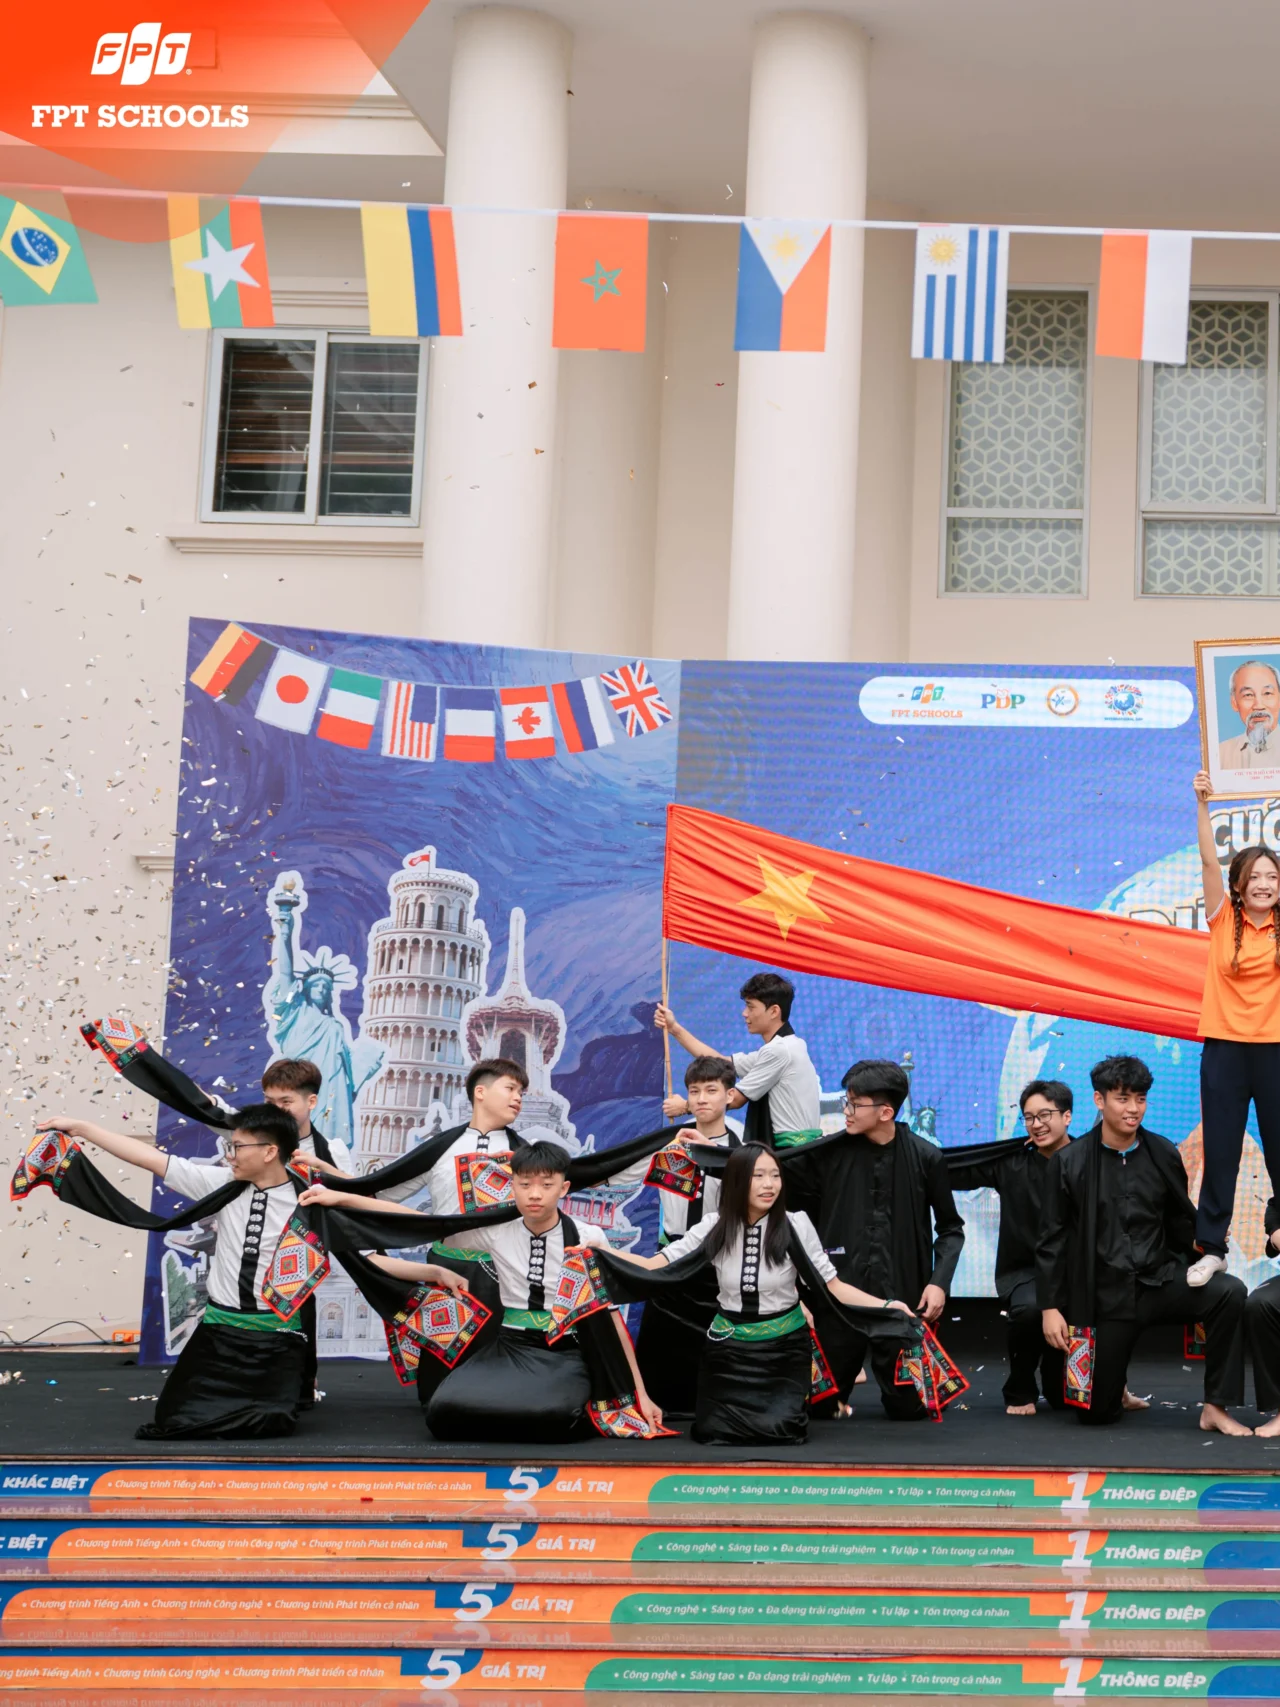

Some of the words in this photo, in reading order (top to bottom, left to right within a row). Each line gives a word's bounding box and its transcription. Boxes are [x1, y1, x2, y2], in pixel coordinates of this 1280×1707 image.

[911, 683, 945, 704] FPT
[981, 692, 1026, 709] PDP
[891, 709, 910, 718] FPT
[912, 709, 963, 718] SCHOOLS
[2, 1474, 49, 1488] KHÁC
[50, 1474, 89, 1491] BIỆT
[115, 1480, 148, 1490] Chương
[150, 1480, 171, 1488] trình
[173, 1480, 197, 1490] Tiếng
[197, 1480, 216, 1488] Anh
[226, 1480, 259, 1491] Chương
[260, 1481, 282, 1489] trình
[282, 1480, 305, 1492] Công
[306, 1481, 329, 1492] nghệ
[338, 1481, 372, 1492] Chương
[373, 1481, 394, 1490] trình
[394, 1481, 416, 1490] Phát
[416, 1481, 437, 1490] triển
[438, 1482, 449, 1490] cá
[450, 1482, 472, 1490] nhân
[503, 1466, 541, 1501] 5
[556, 1478, 582, 1492] GIÁ
[587, 1481, 614, 1494] TRỊ
[1061, 1472, 1090, 1508] 1
[1102, 1486, 1156, 1501] THÔNG
[1159, 1486, 1197, 1503] ĐIỆP
[7, 1534, 48, 1550] BIỆT
[480, 1523, 522, 1560] 5
[536, 1536, 563, 1550] GIÁ
[568, 1538, 596, 1552] TRỊ
[1061, 1531, 1092, 1567] 1
[1104, 1544, 1160, 1560] THÔNG
[1163, 1546, 1203, 1563] ĐIỆP
[454, 1583, 496, 1621] 5
[511, 1596, 540, 1611] GIÁ
[545, 1598, 574, 1614] TRỊ
[1058, 1591, 1091, 1629] 1
[1103, 1604, 1161, 1620] THÔNG
[1165, 1605, 1206, 1622] ĐIỆP
[12, 1668, 40, 1678] trình
[42, 1668, 70, 1680] Tiếng
[70, 1668, 92, 1678] Anh
[103, 1668, 142, 1680] Chương
[142, 1668, 167, 1678] trình
[168, 1668, 194, 1679] Công
[195, 1667, 221, 1680] nghệ
[232, 1667, 270, 1679] Chương
[271, 1667, 296, 1677] trình
[297, 1667, 320, 1677] Phát
[321, 1666, 345, 1677] triển
[346, 1668, 358, 1677] cá
[359, 1667, 385, 1677] nhân
[420, 1649, 465, 1689] 5
[480, 1662, 510, 1678] GIÁ
[516, 1665, 546, 1680] TRỊ
[622, 1670, 650, 1682] Công
[650, 1670, 678, 1682] nghệ
[690, 1670, 716, 1682] Sáng
[717, 1672, 735, 1681] tạo
[747, 1671, 762, 1681] Đa
[763, 1671, 790, 1684] dạng
[792, 1672, 810, 1682] trải
[811, 1672, 851, 1684] nghiệm
[867, 1673, 881, 1684] Tự
[881, 1673, 898, 1685] lập
[911, 1674, 930, 1684] Tôn
[931, 1675, 960, 1686] trọng
[961, 1675, 974, 1684] cá
[975, 1675, 1002, 1685] nhân
[1053, 1658, 1086, 1696] 1
[1100, 1671, 1160, 1687] THÔNG
[1164, 1672, 1207, 1690] ĐIỆP
